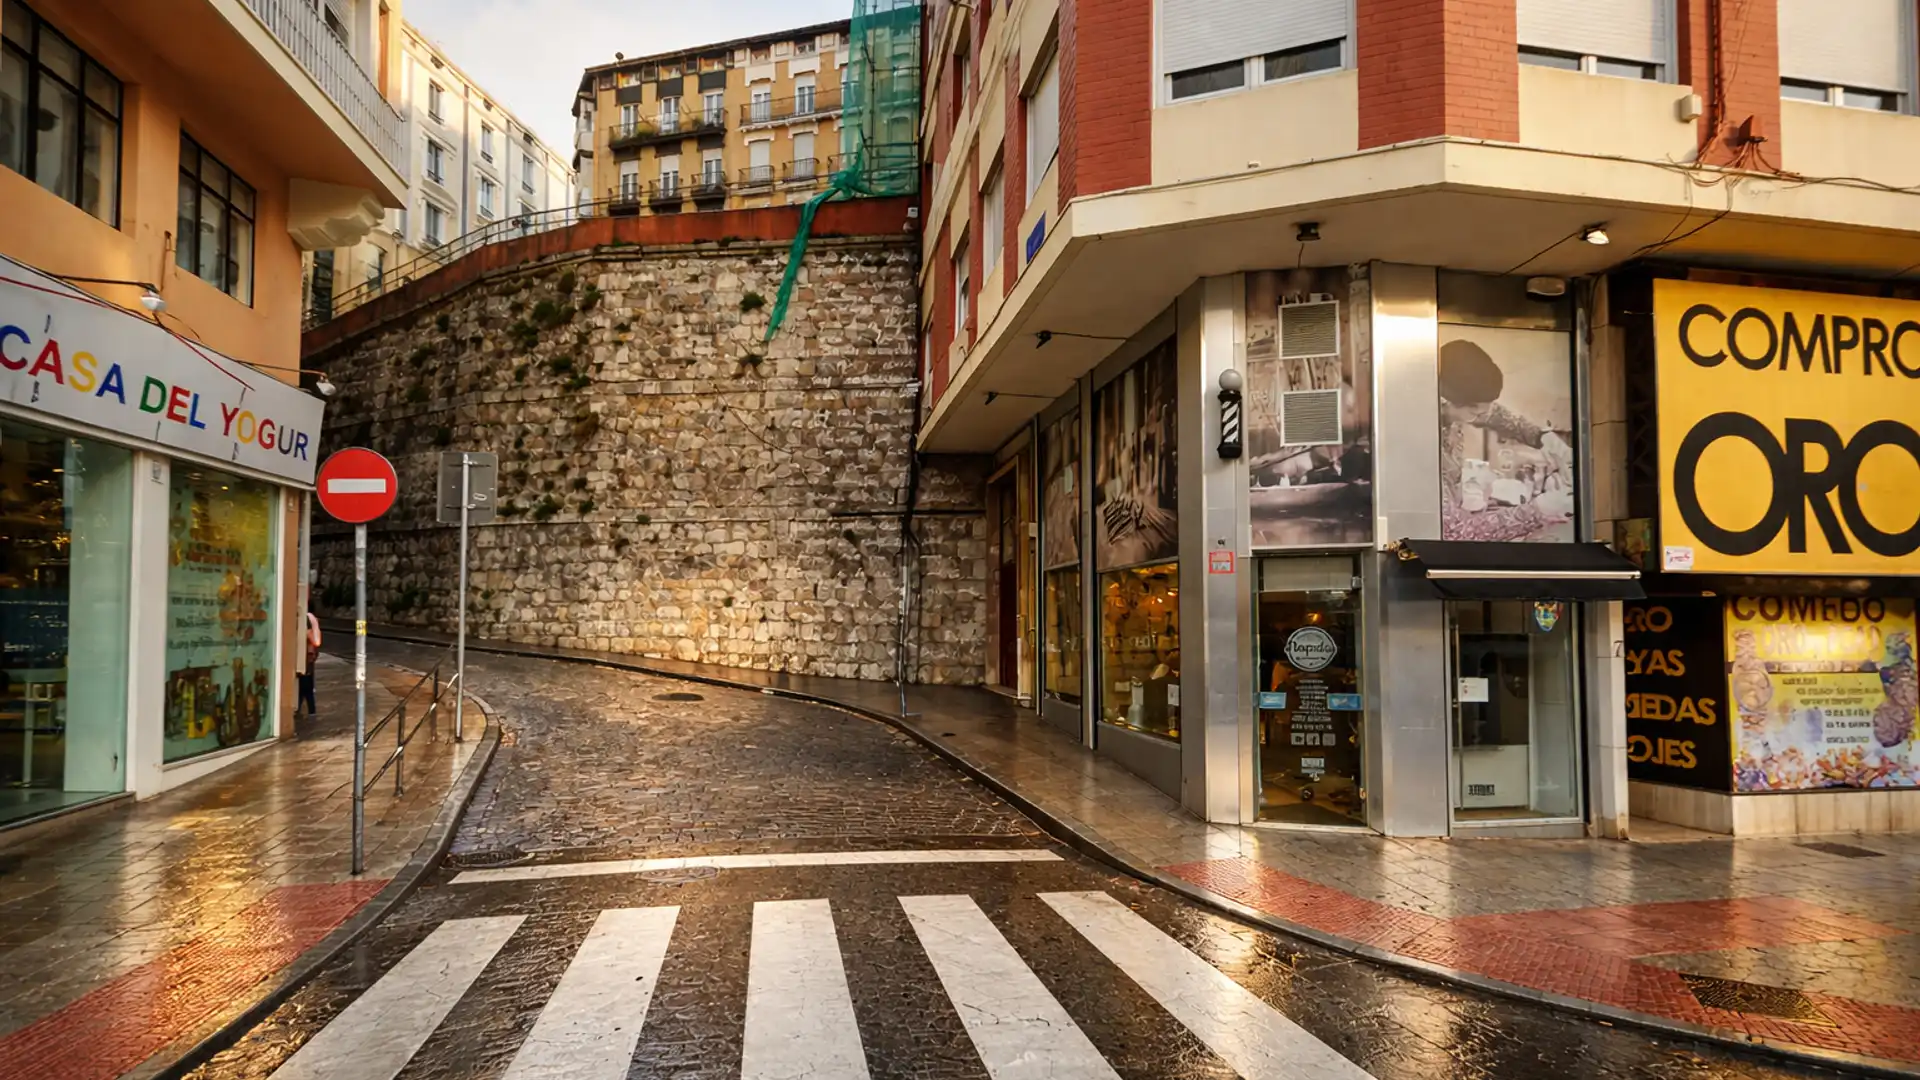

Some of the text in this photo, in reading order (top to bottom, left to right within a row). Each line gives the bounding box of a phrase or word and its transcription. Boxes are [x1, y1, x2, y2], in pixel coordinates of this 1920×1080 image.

[0, 325, 309, 461] CASA DEL YOGUR
[1679, 303, 1920, 379] COMPRO
[1673, 411, 1920, 557] ORO
[1613, 640, 1624, 657] 7
